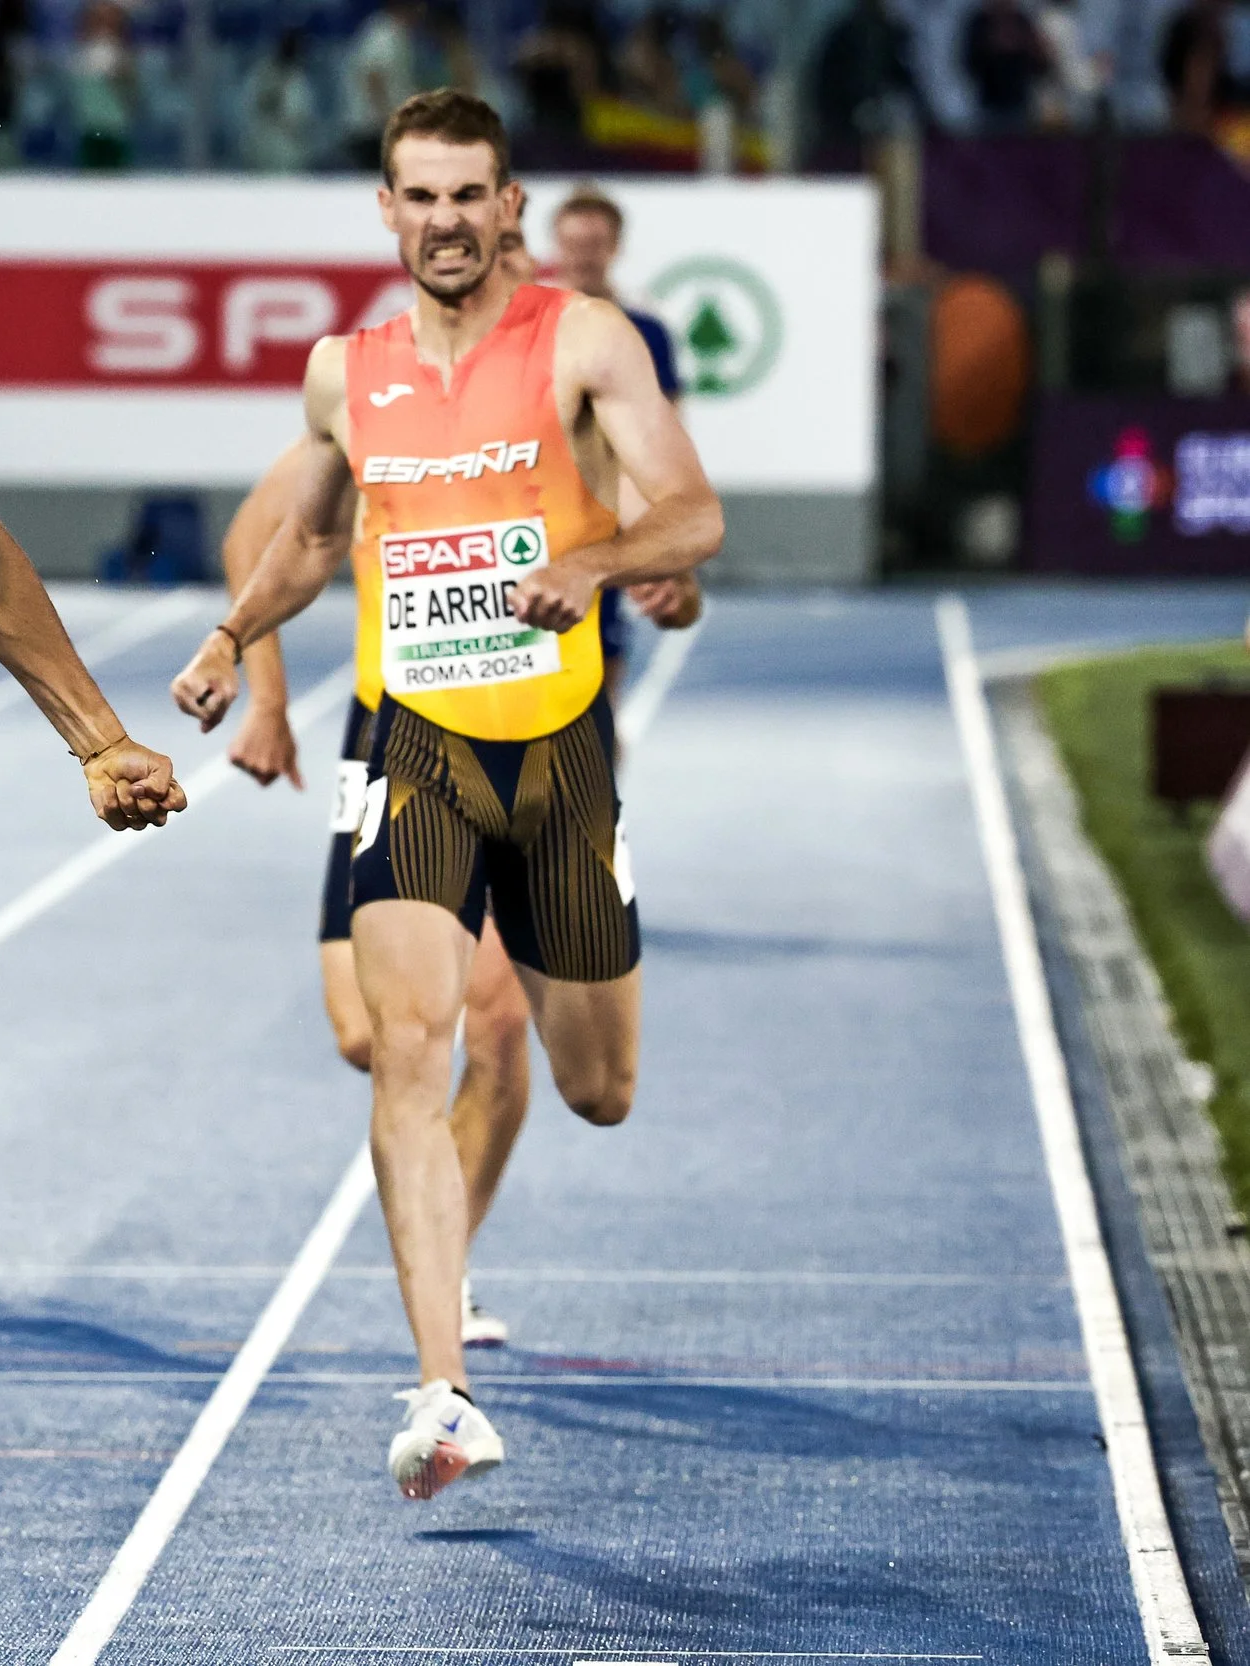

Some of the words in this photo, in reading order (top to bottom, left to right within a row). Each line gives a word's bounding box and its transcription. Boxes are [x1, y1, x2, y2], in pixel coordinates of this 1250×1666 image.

[363, 439, 540, 484] ESPAÑA
[385, 534, 496, 575] SPAR
[388, 591, 417, 630] DE
[427, 580, 519, 627] ARRID
[405, 663, 473, 685] ROMA
[478, 654, 534, 679] 2024
